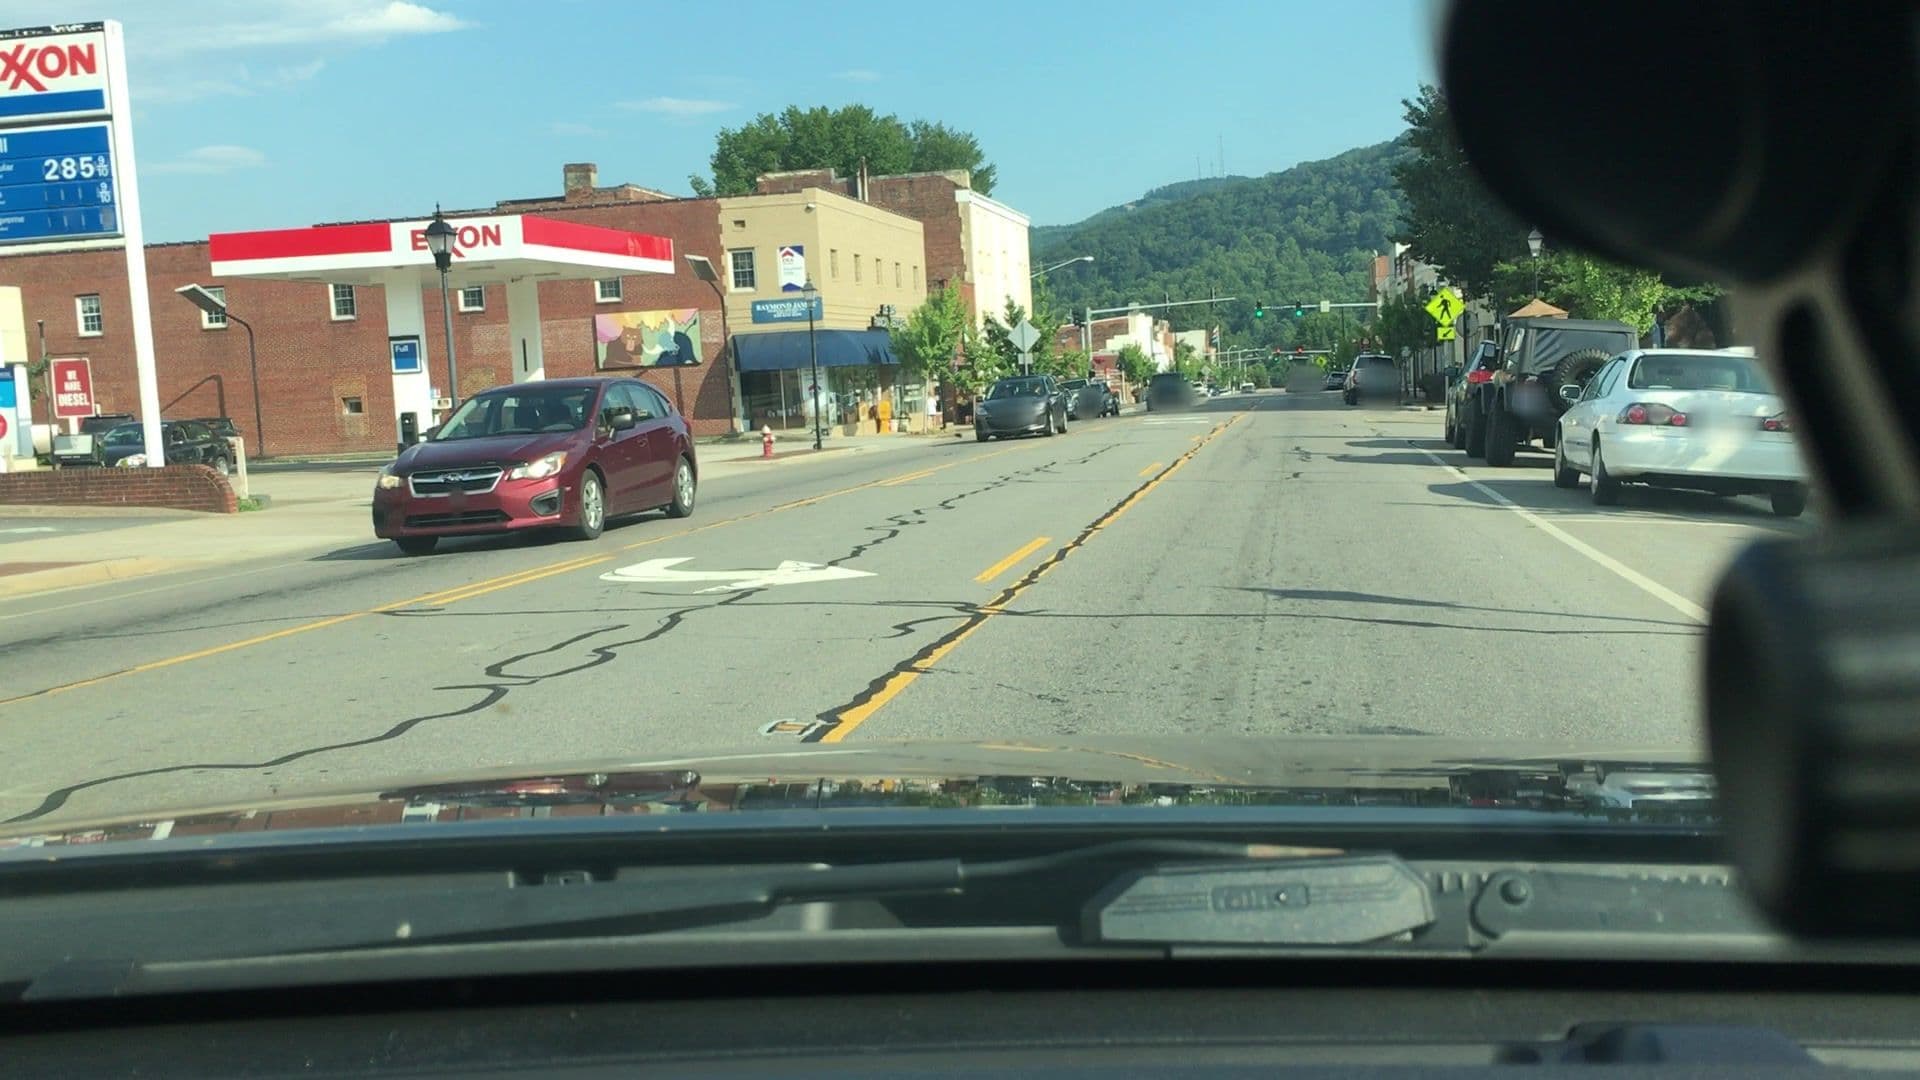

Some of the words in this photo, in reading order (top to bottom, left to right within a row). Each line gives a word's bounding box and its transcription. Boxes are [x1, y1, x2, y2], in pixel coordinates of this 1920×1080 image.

[44, 156, 95, 180] 285
[411, 224, 502, 258] EON
[791, 300, 817, 309] JAM
[58, 394, 89, 406] DIESEL
